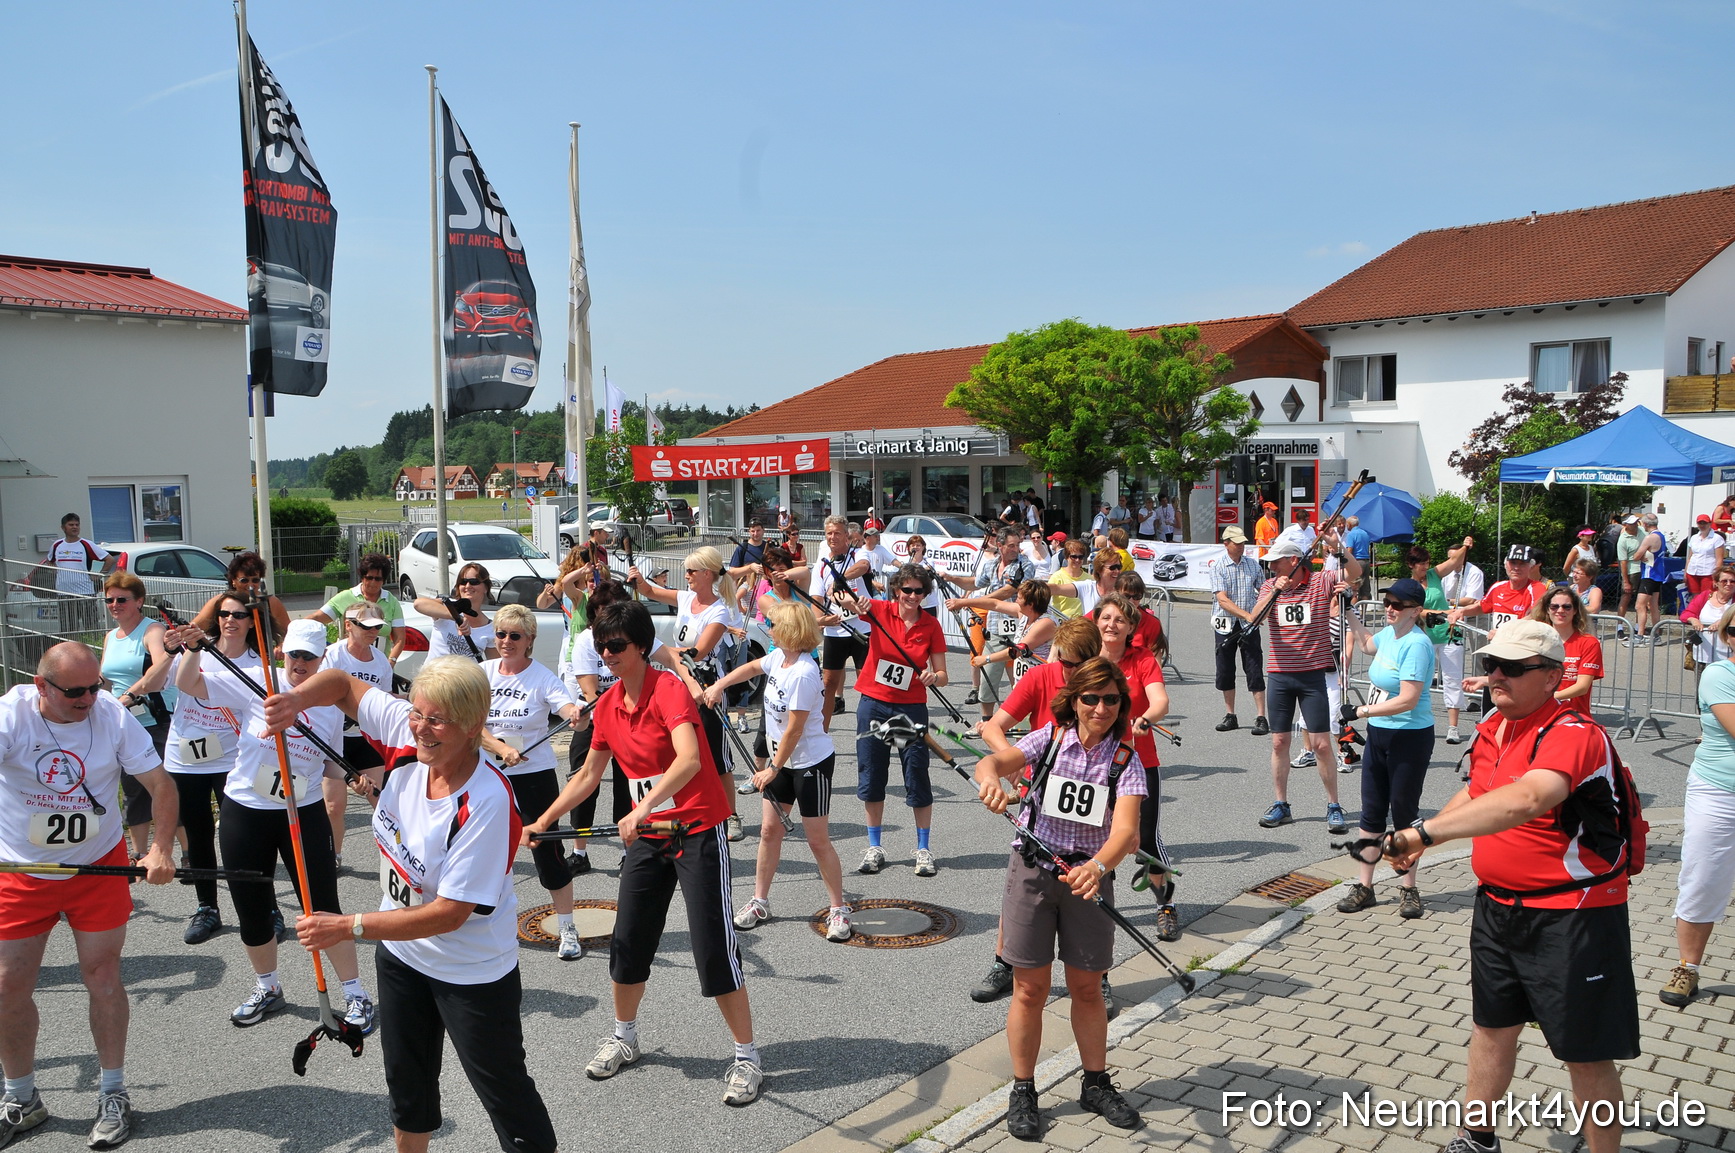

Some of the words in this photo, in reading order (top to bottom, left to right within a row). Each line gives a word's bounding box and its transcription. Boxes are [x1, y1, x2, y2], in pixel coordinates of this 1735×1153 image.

[256, 199, 331, 225] RAV-SYSTEM
[449, 233, 465, 245] MIT
[512, 368, 532, 376] VOLVO
[857, 440, 911, 454] Gerhart
[915, 439, 925, 453] &
[927, 437, 969, 455] Jänig
[1225, 440, 1318, 455] erviceannahme
[1556, 471, 1596, 480] Neumarkter
[1598, 471, 1628, 482] Tagblatt
[927, 549, 971, 562] GERHART
[1003, 620, 1016, 633] 35
[1214, 618, 1226, 630] 34
[679, 625, 688, 641] 6
[883, 664, 905, 685] 43
[490, 688, 528, 701] ERGER
[503, 708, 529, 717] GIRLS
[188, 737, 207, 760] 17
[286, 741, 300, 749] MIT
[302, 745, 321, 757] HERZ
[37, 801, 55, 809] Heck
[1058, 781, 1095, 817] 69
[46, 813, 87, 845] 20
